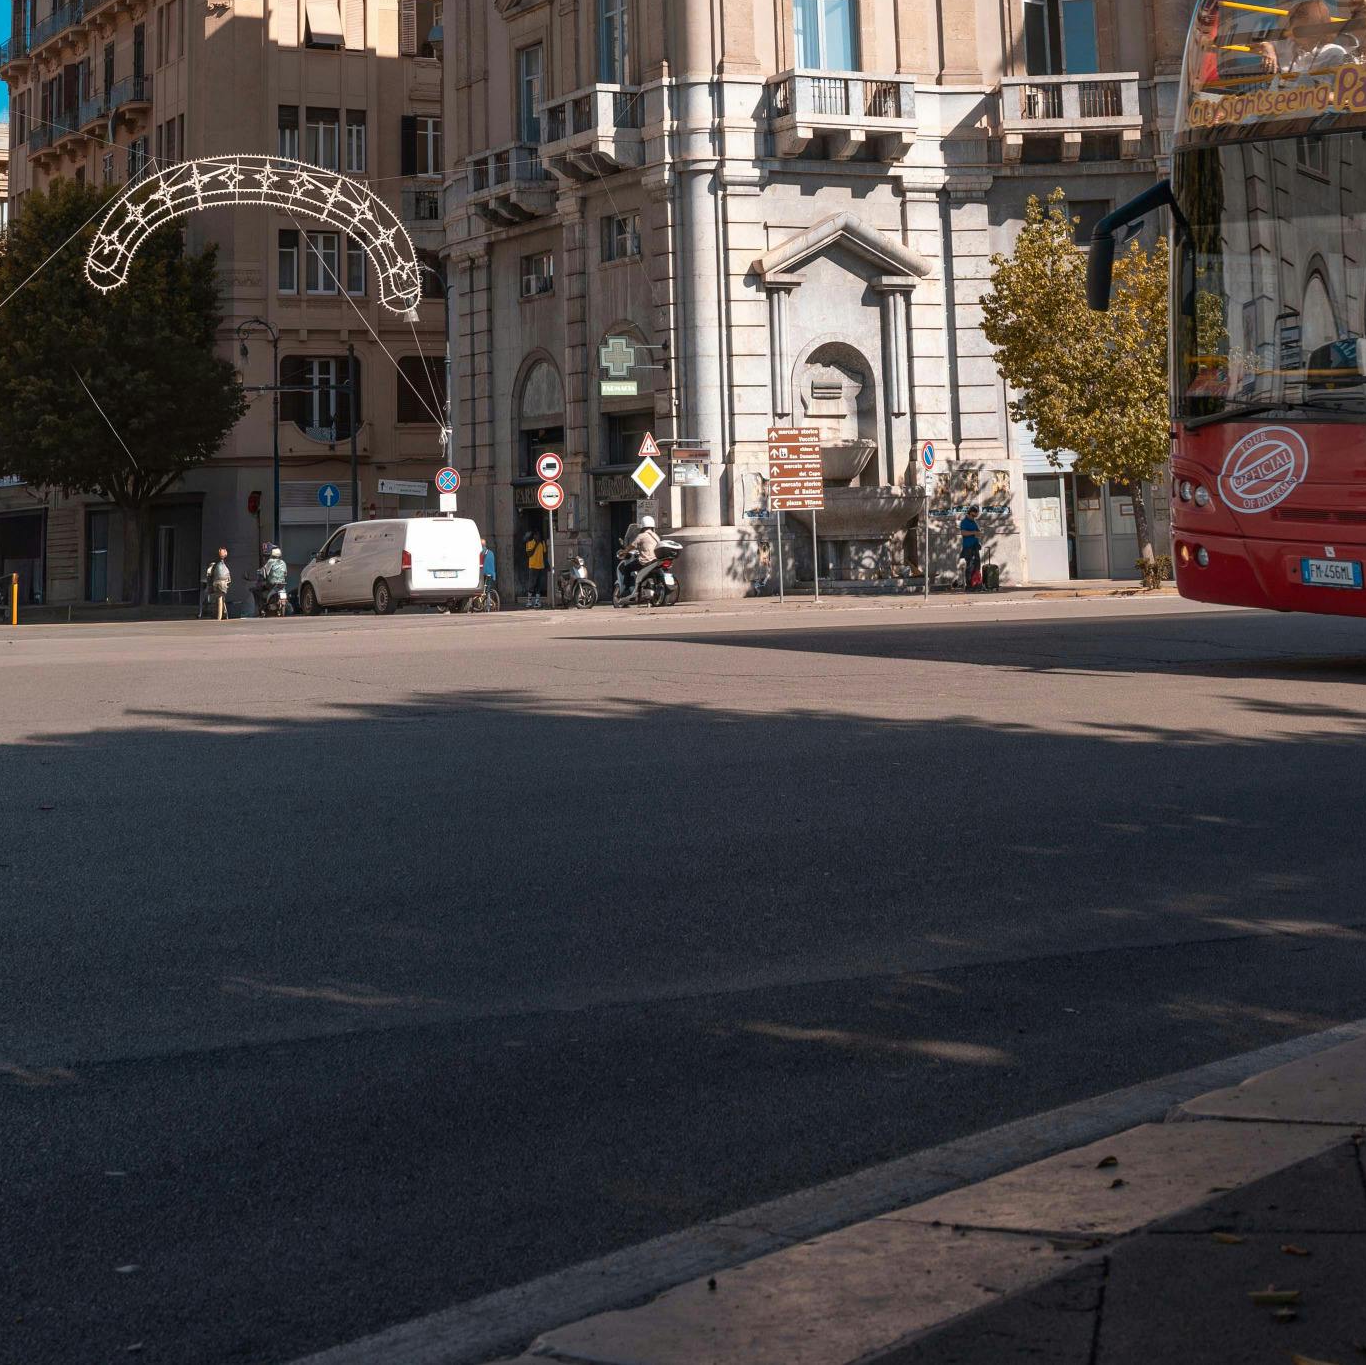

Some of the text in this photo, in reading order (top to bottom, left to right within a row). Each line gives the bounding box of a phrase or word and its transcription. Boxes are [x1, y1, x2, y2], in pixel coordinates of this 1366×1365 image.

[1239, 432, 1268, 453] TOUR
[1234, 450, 1291, 488] OFFICIAL
[1243, 476, 1298, 509] OF PALERMO
